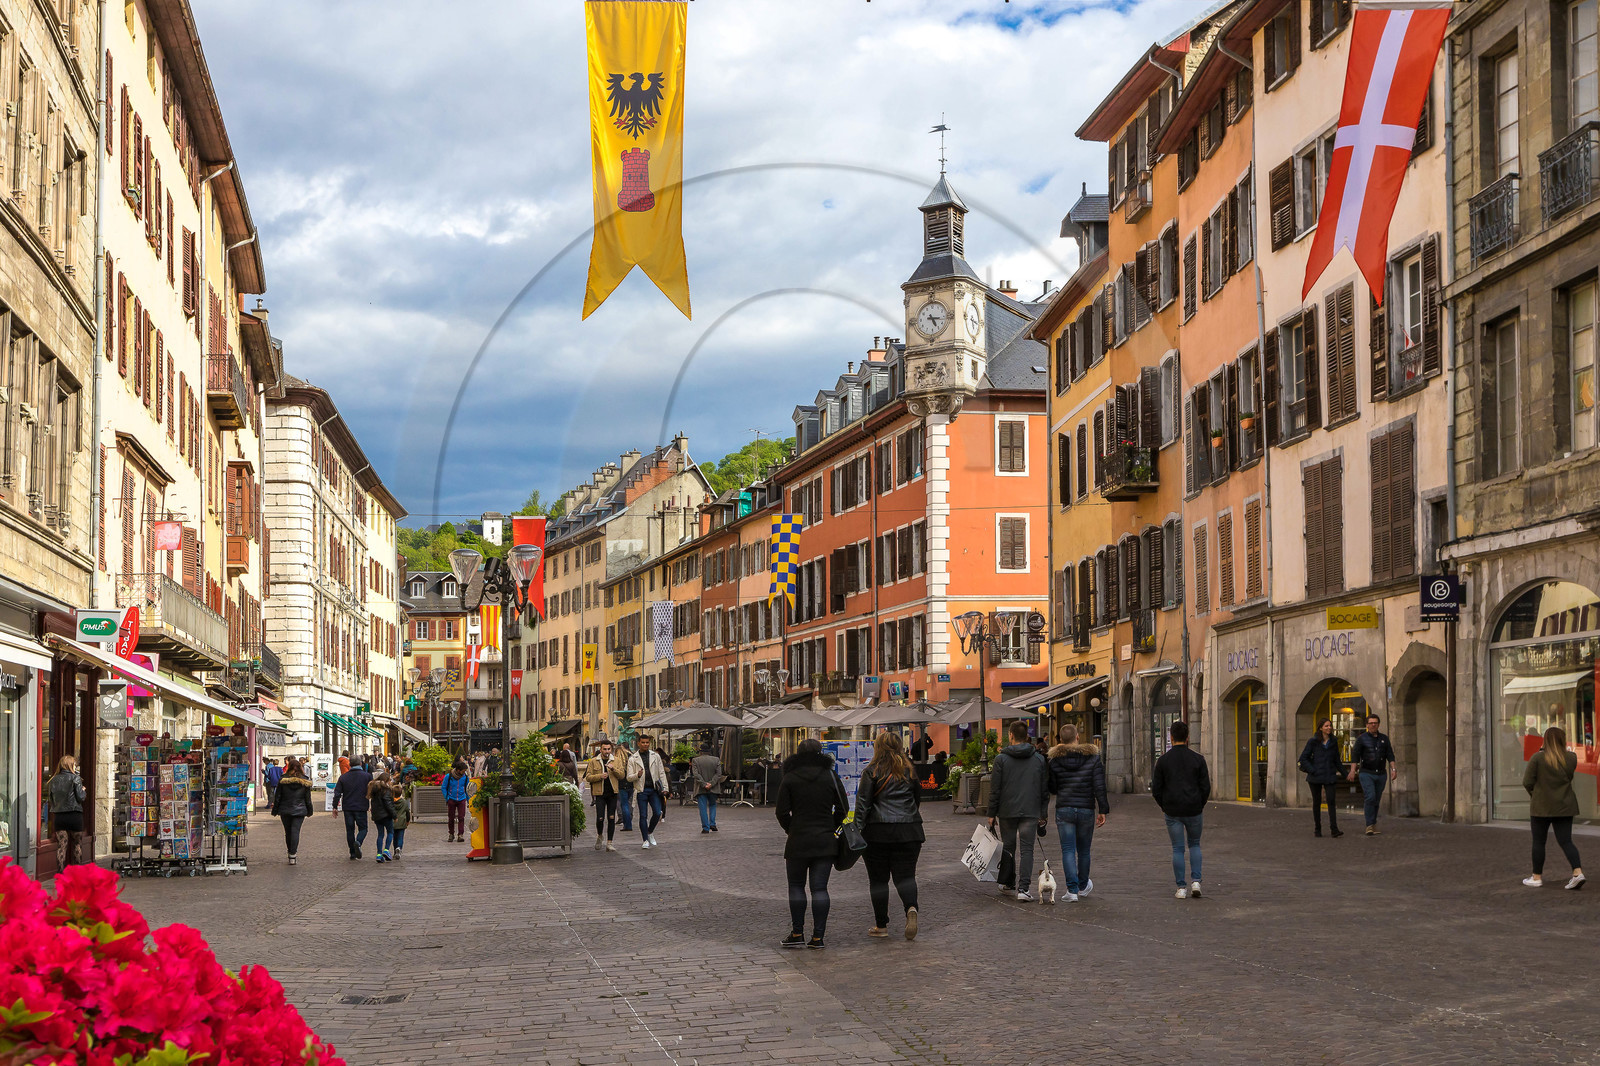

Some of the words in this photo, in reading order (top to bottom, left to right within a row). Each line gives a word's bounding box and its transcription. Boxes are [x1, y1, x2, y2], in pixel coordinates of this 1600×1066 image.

[82, 623, 102, 631] PMU
[1330, 613, 1371, 624] BOCAGE
[1305, 631, 1354, 661] BOCAGE
[1228, 647, 1259, 672] BOCAGE
